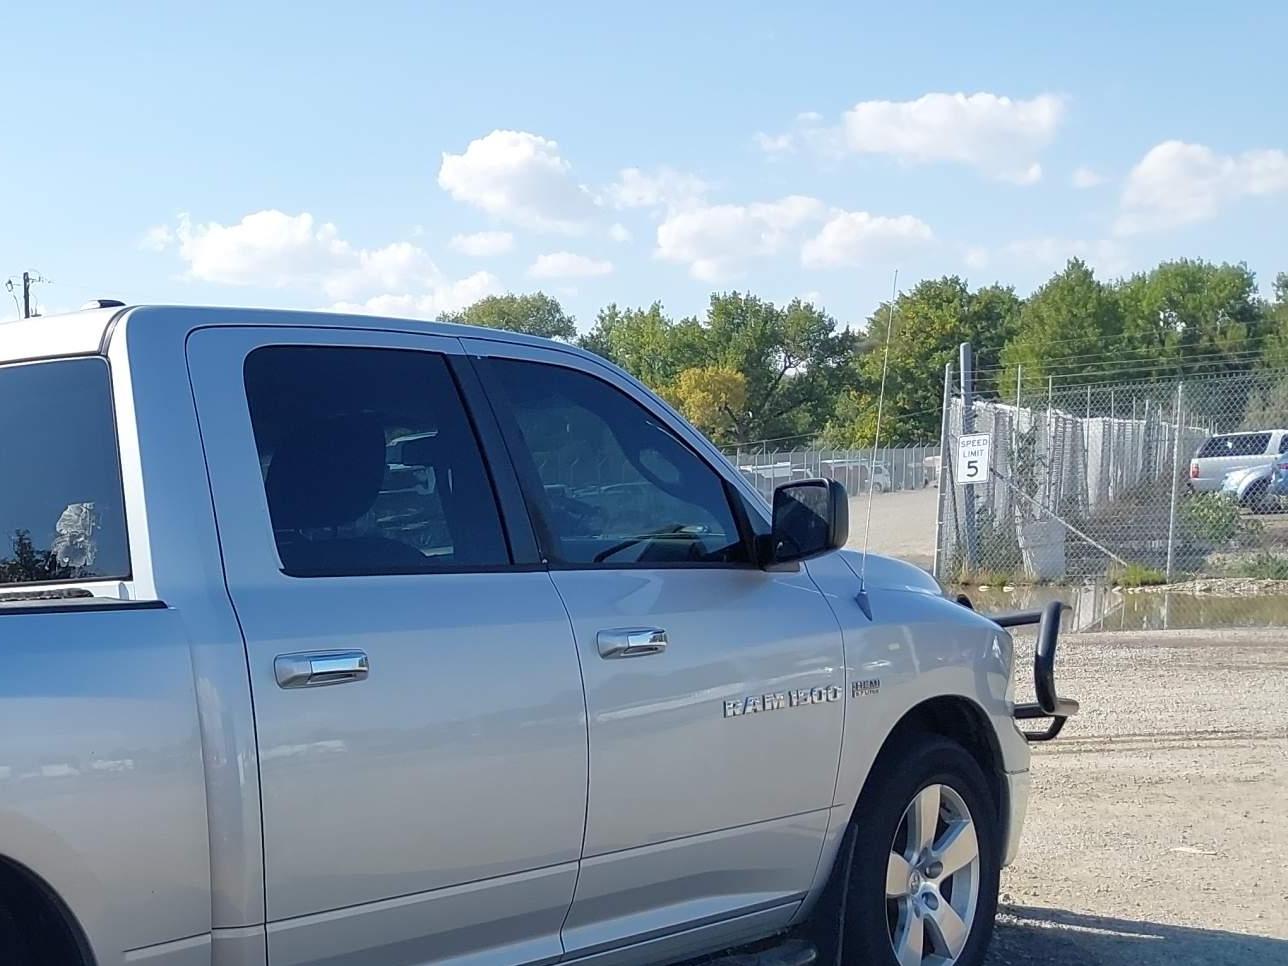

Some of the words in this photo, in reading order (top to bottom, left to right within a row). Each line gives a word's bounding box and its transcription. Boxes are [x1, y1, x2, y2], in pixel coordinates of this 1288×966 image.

[960, 438, 988, 448] SPEED
[962, 449, 984, 458] LIMIT
[966, 460, 978, 477] 5
[723, 694, 785, 718] RAM
[788, 685, 842, 707] 1500
